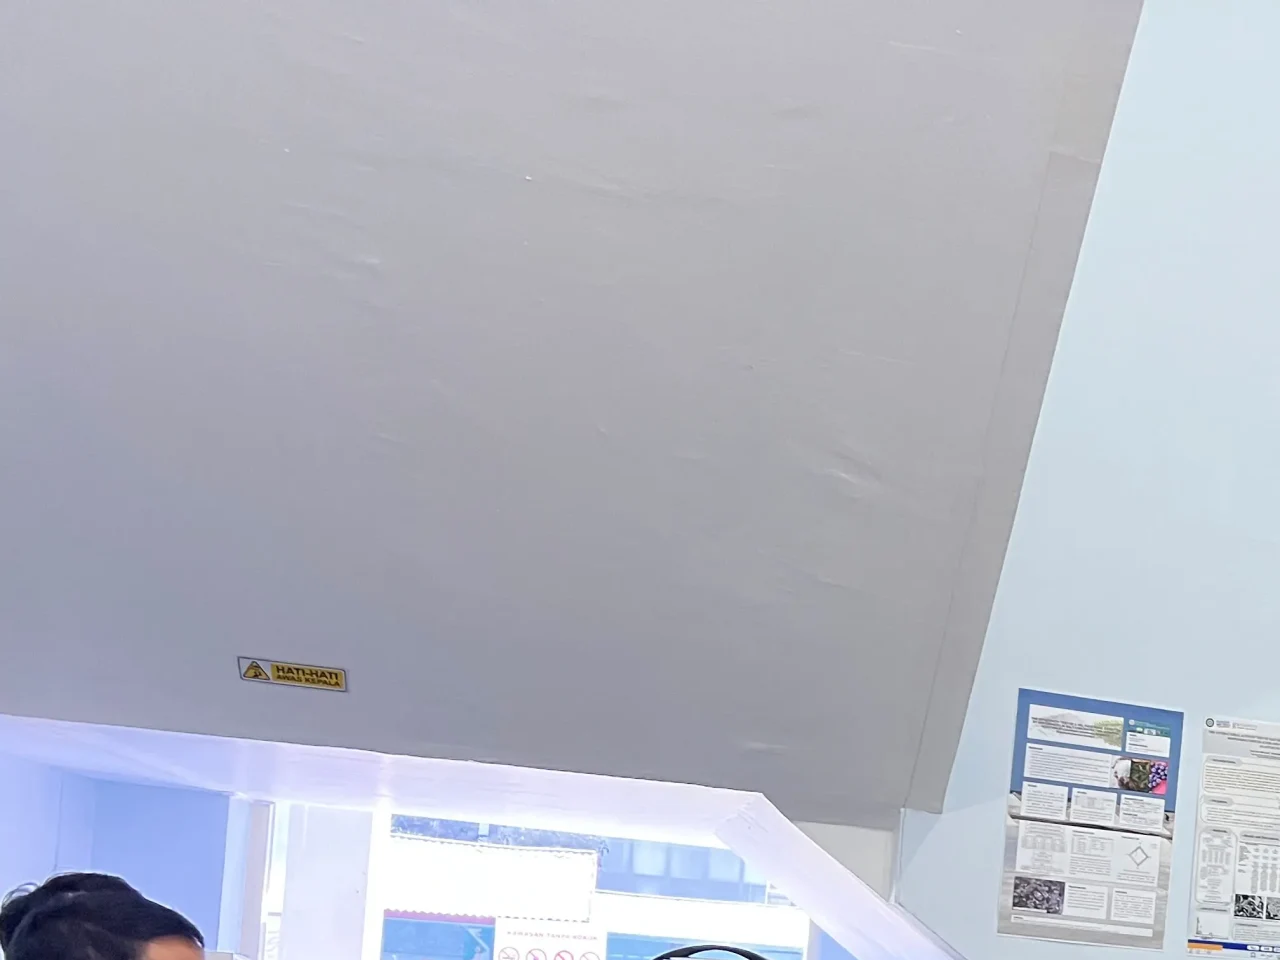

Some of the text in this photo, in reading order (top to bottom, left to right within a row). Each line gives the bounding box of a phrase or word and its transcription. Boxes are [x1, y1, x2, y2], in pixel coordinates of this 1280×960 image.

[276, 665, 338, 680] HATI-HATI
[277, 675, 341, 687] AWAS KEPALA
